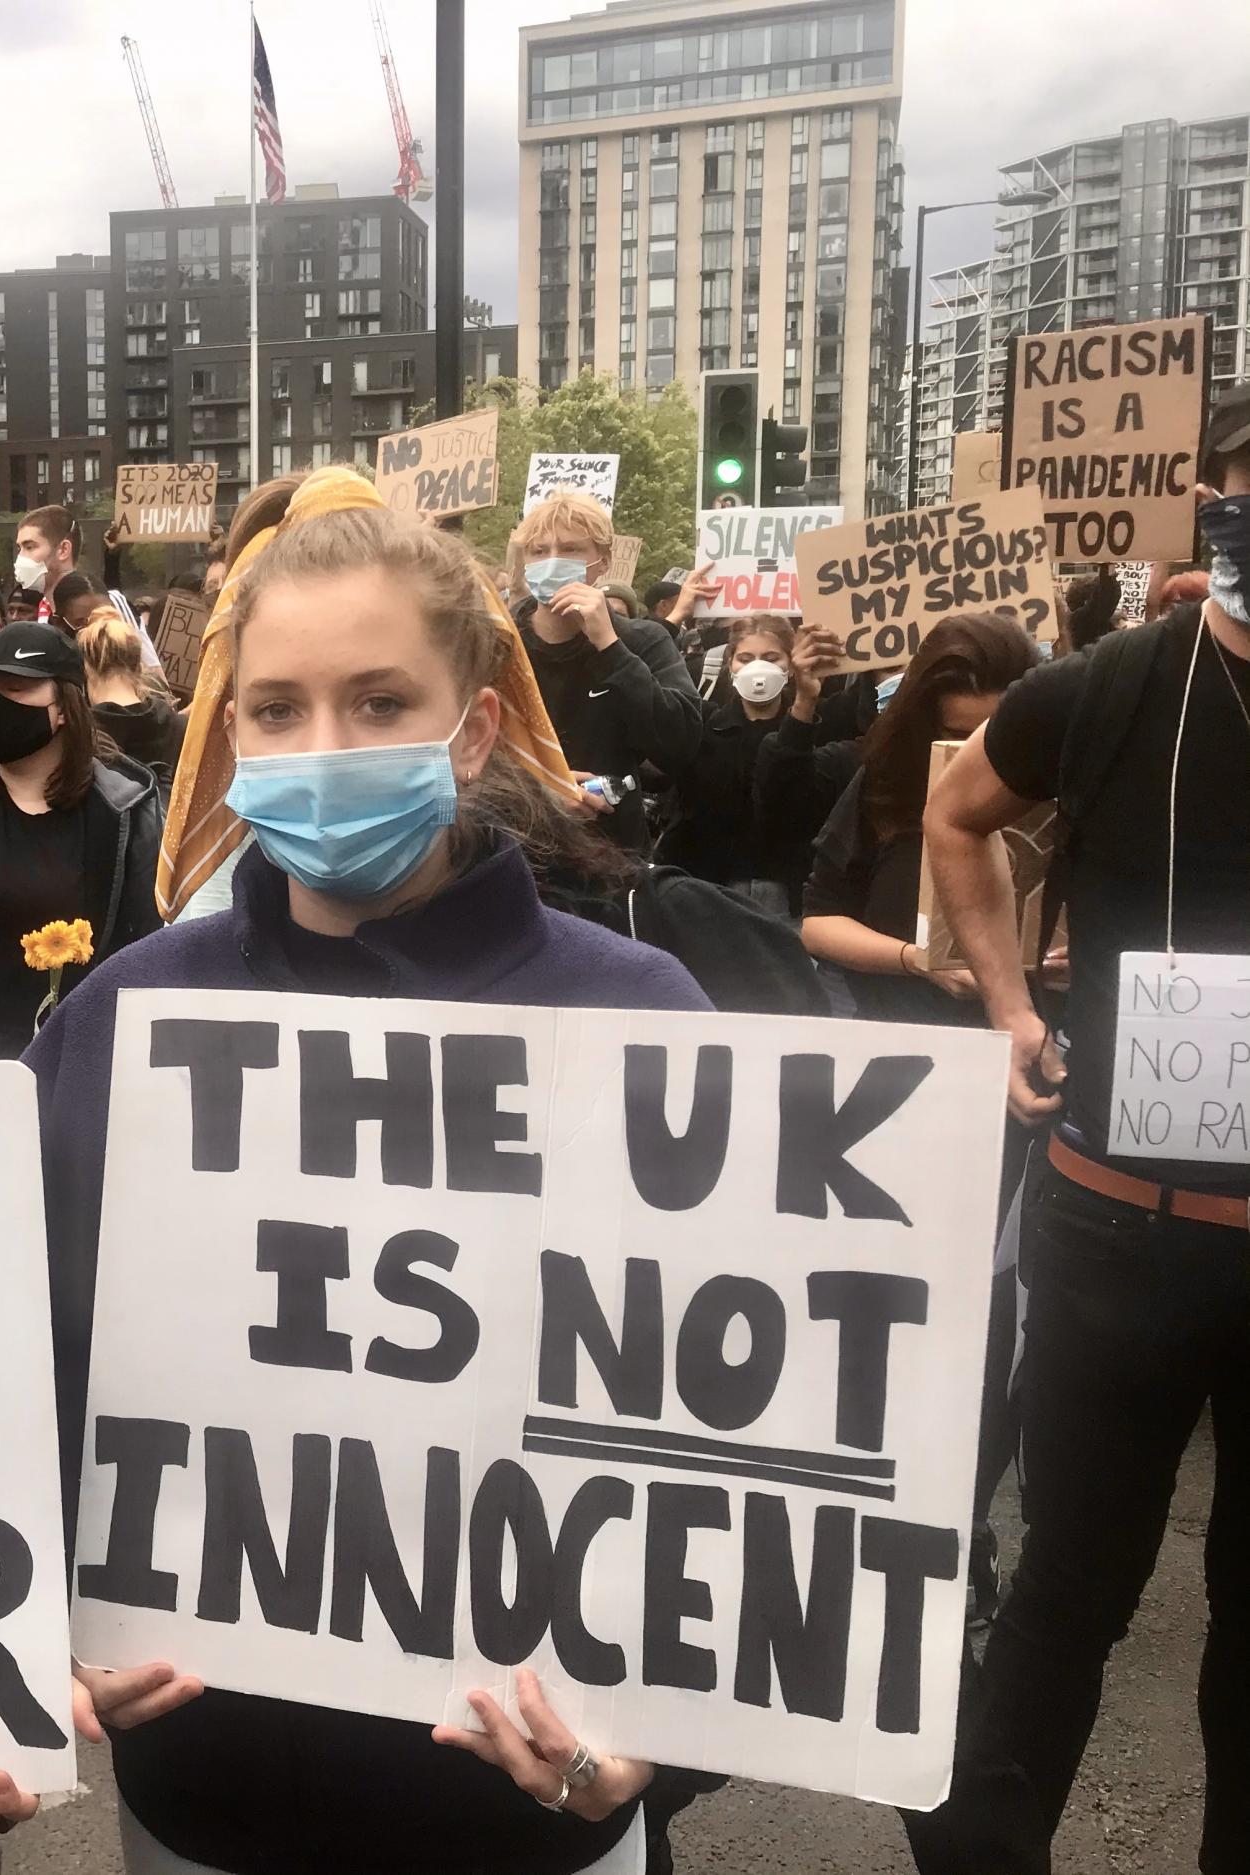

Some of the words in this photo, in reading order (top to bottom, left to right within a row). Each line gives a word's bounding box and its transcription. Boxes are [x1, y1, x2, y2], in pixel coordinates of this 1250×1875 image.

[1024, 328, 1195, 389] RACISM
[1042, 398, 1086, 442] IS
[1114, 393, 1144, 433] A
[121, 466, 159, 481] ITS
[166, 465, 214, 481] 2020
[383, 436, 422, 476] NO
[430, 425, 496, 463] JUSTICE
[161, 484, 186, 504] ME
[188, 484, 213, 505] AS
[414, 458, 494, 511] PEACE
[1016, 452, 1191, 499] PANDEMIC
[117, 512, 132, 534] A
[139, 506, 210, 534] HUMAN
[706, 515, 832, 560] SILEN
[866, 503, 985, 547] WHATS
[1044, 510, 1135, 557] TOO
[817, 526, 1047, 595] SUSPICIOUS?
[851, 584, 910, 625] MY
[924, 565, 1029, 612] SKIN
[1134, 974, 1201, 1014] NO
[1130, 1038, 1202, 1082] NO
[150, 1019, 542, 1196] THE
[624, 1044, 935, 1226] UK
[1117, 1099, 1171, 1145] NO
[1197, 1101, 1248, 1150] RA
[249, 1219, 480, 1384] IS
[538, 1250, 928, 1451] NOT
[77, 1416, 959, 1734] INNOCENT
